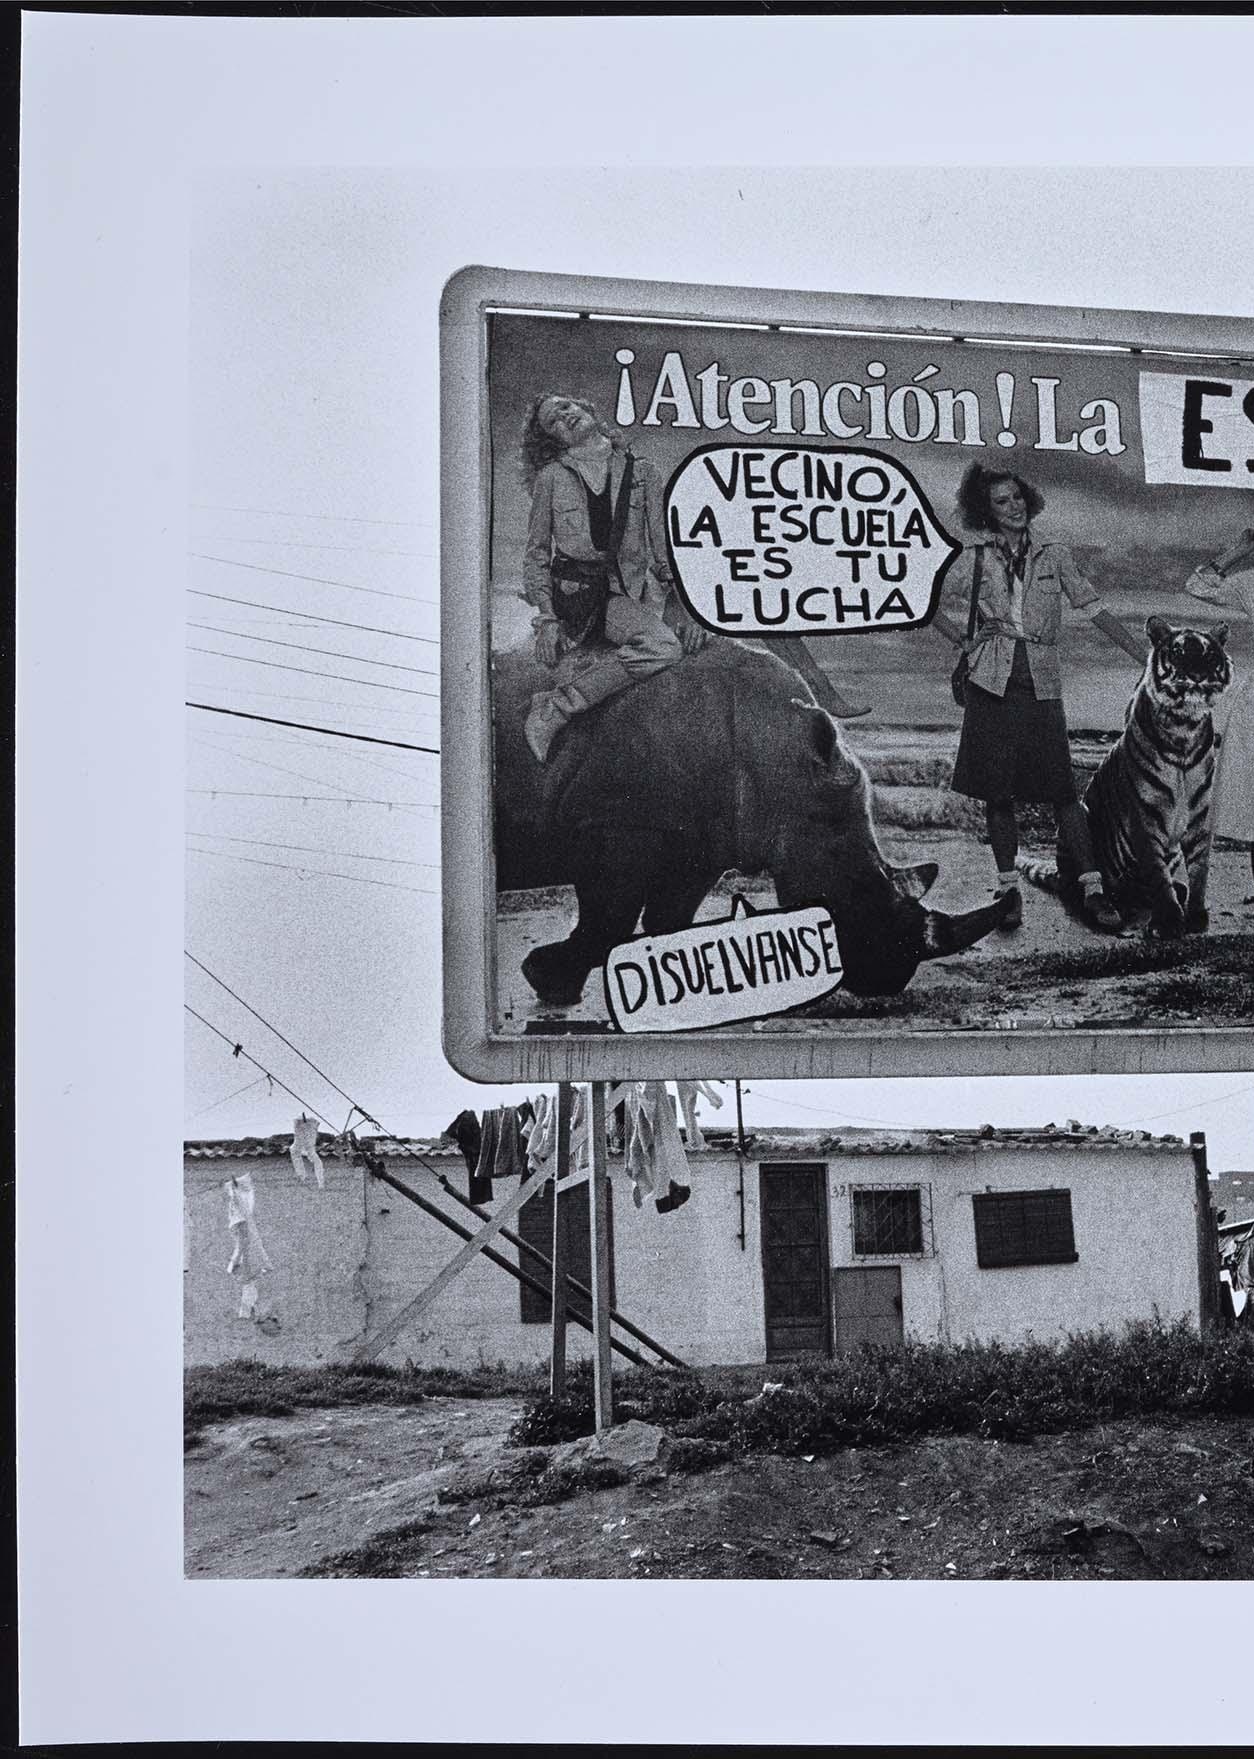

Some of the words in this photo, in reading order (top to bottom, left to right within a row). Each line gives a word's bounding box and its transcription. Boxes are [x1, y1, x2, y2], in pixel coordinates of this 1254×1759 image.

[1031, 376, 1127, 456] La
[703, 452, 907, 505] VECINO,
[671, 506, 721, 548] LA
[753, 506, 931, 548] ESCUELA
[722, 547, 792, 582] ES
[836, 550, 907, 582] TU
[715, 586, 916, 624] LUCHA
[614, 920, 842, 1014] DISUELVANSE
